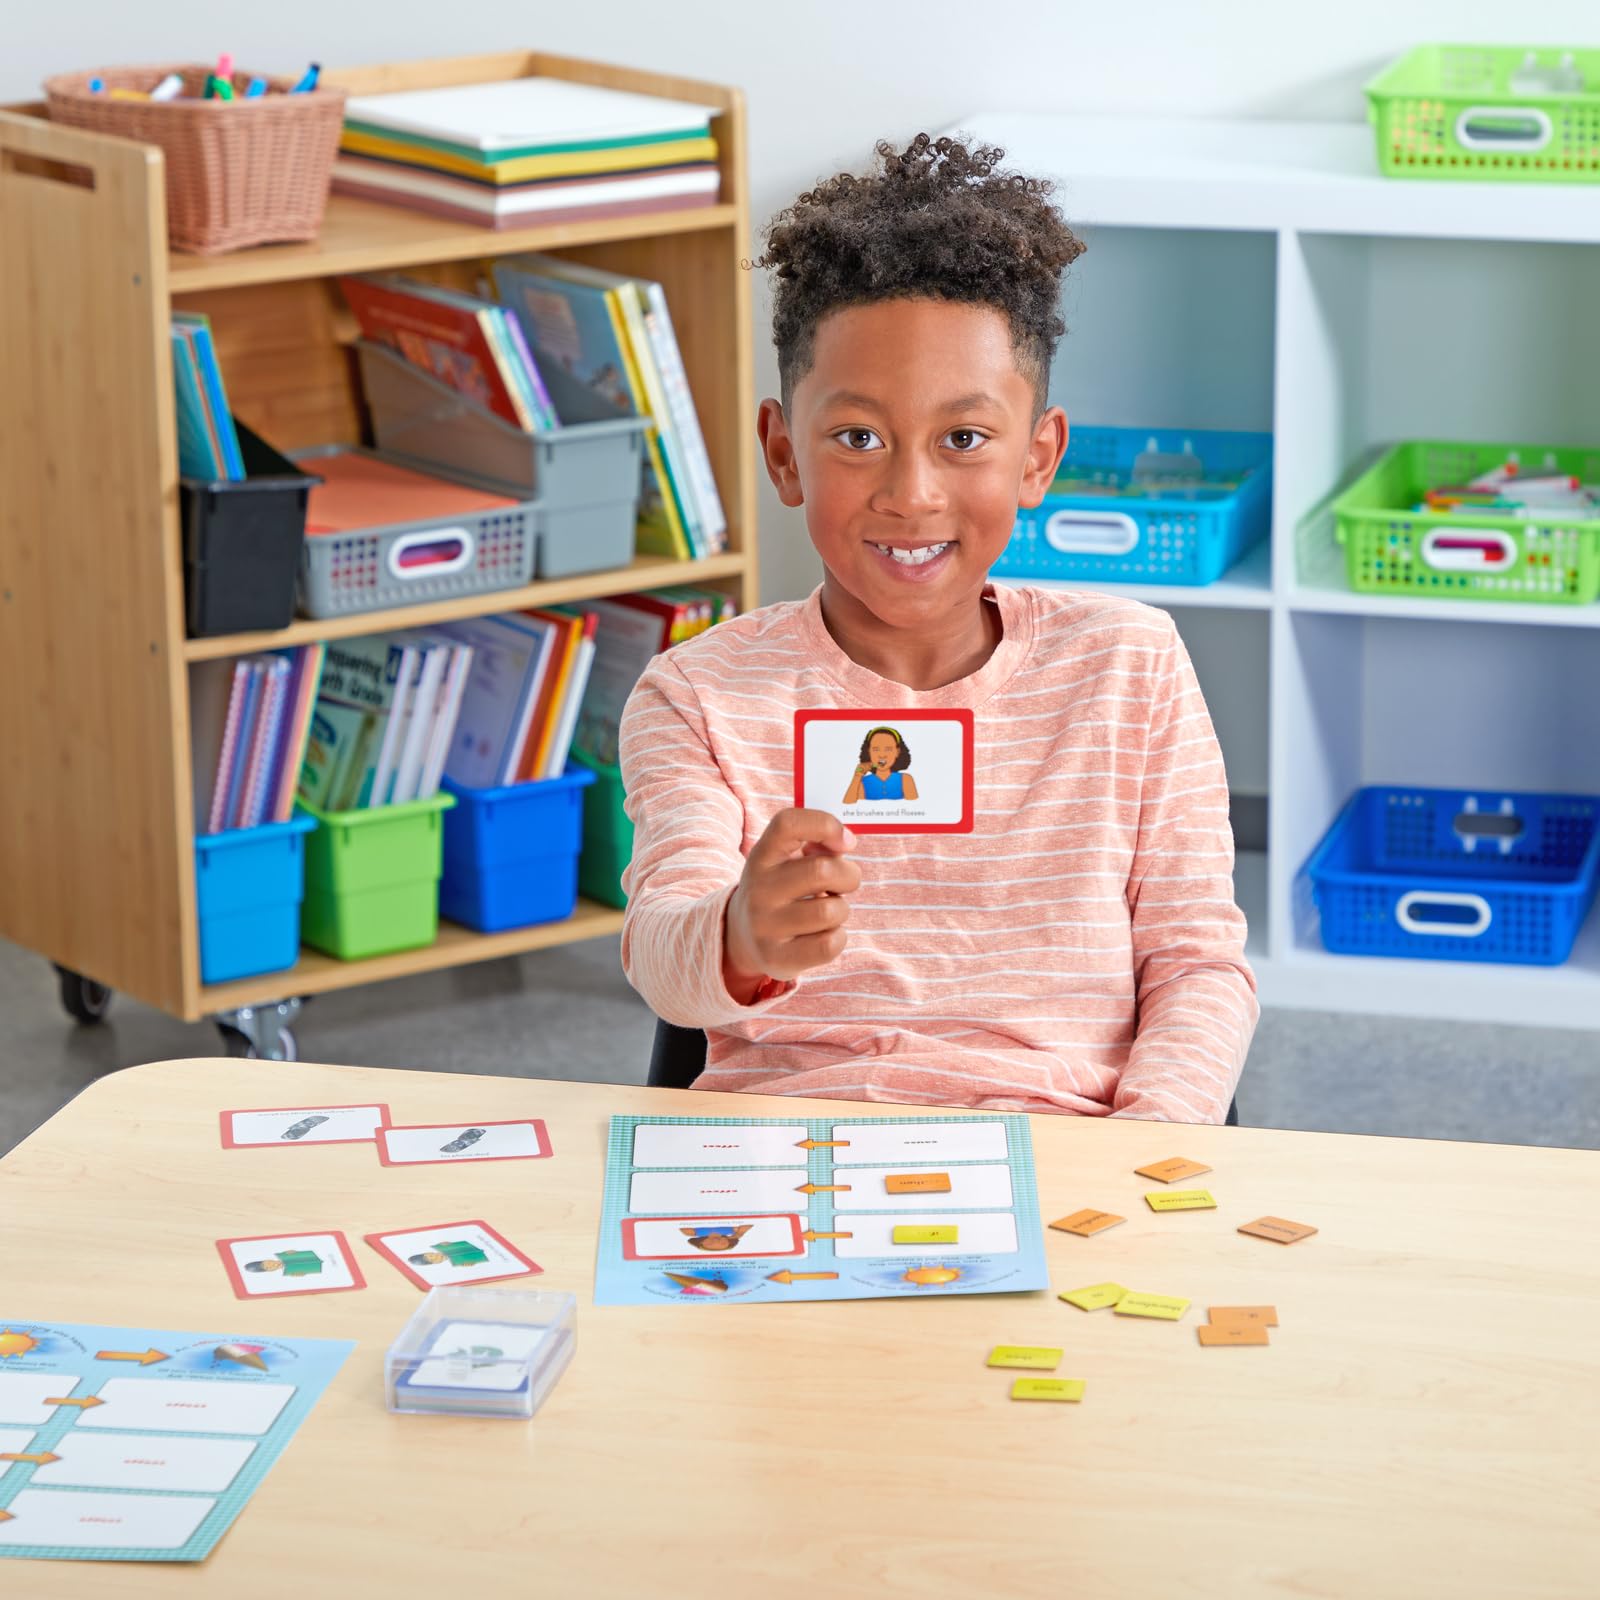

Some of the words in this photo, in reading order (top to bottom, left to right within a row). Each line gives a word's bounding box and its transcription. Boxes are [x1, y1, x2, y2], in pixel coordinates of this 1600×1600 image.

[843, 808, 855, 817] she
[856, 808, 884, 817] brushes
[885, 808, 900, 817] and
[900, 808, 925, 817] flosses
